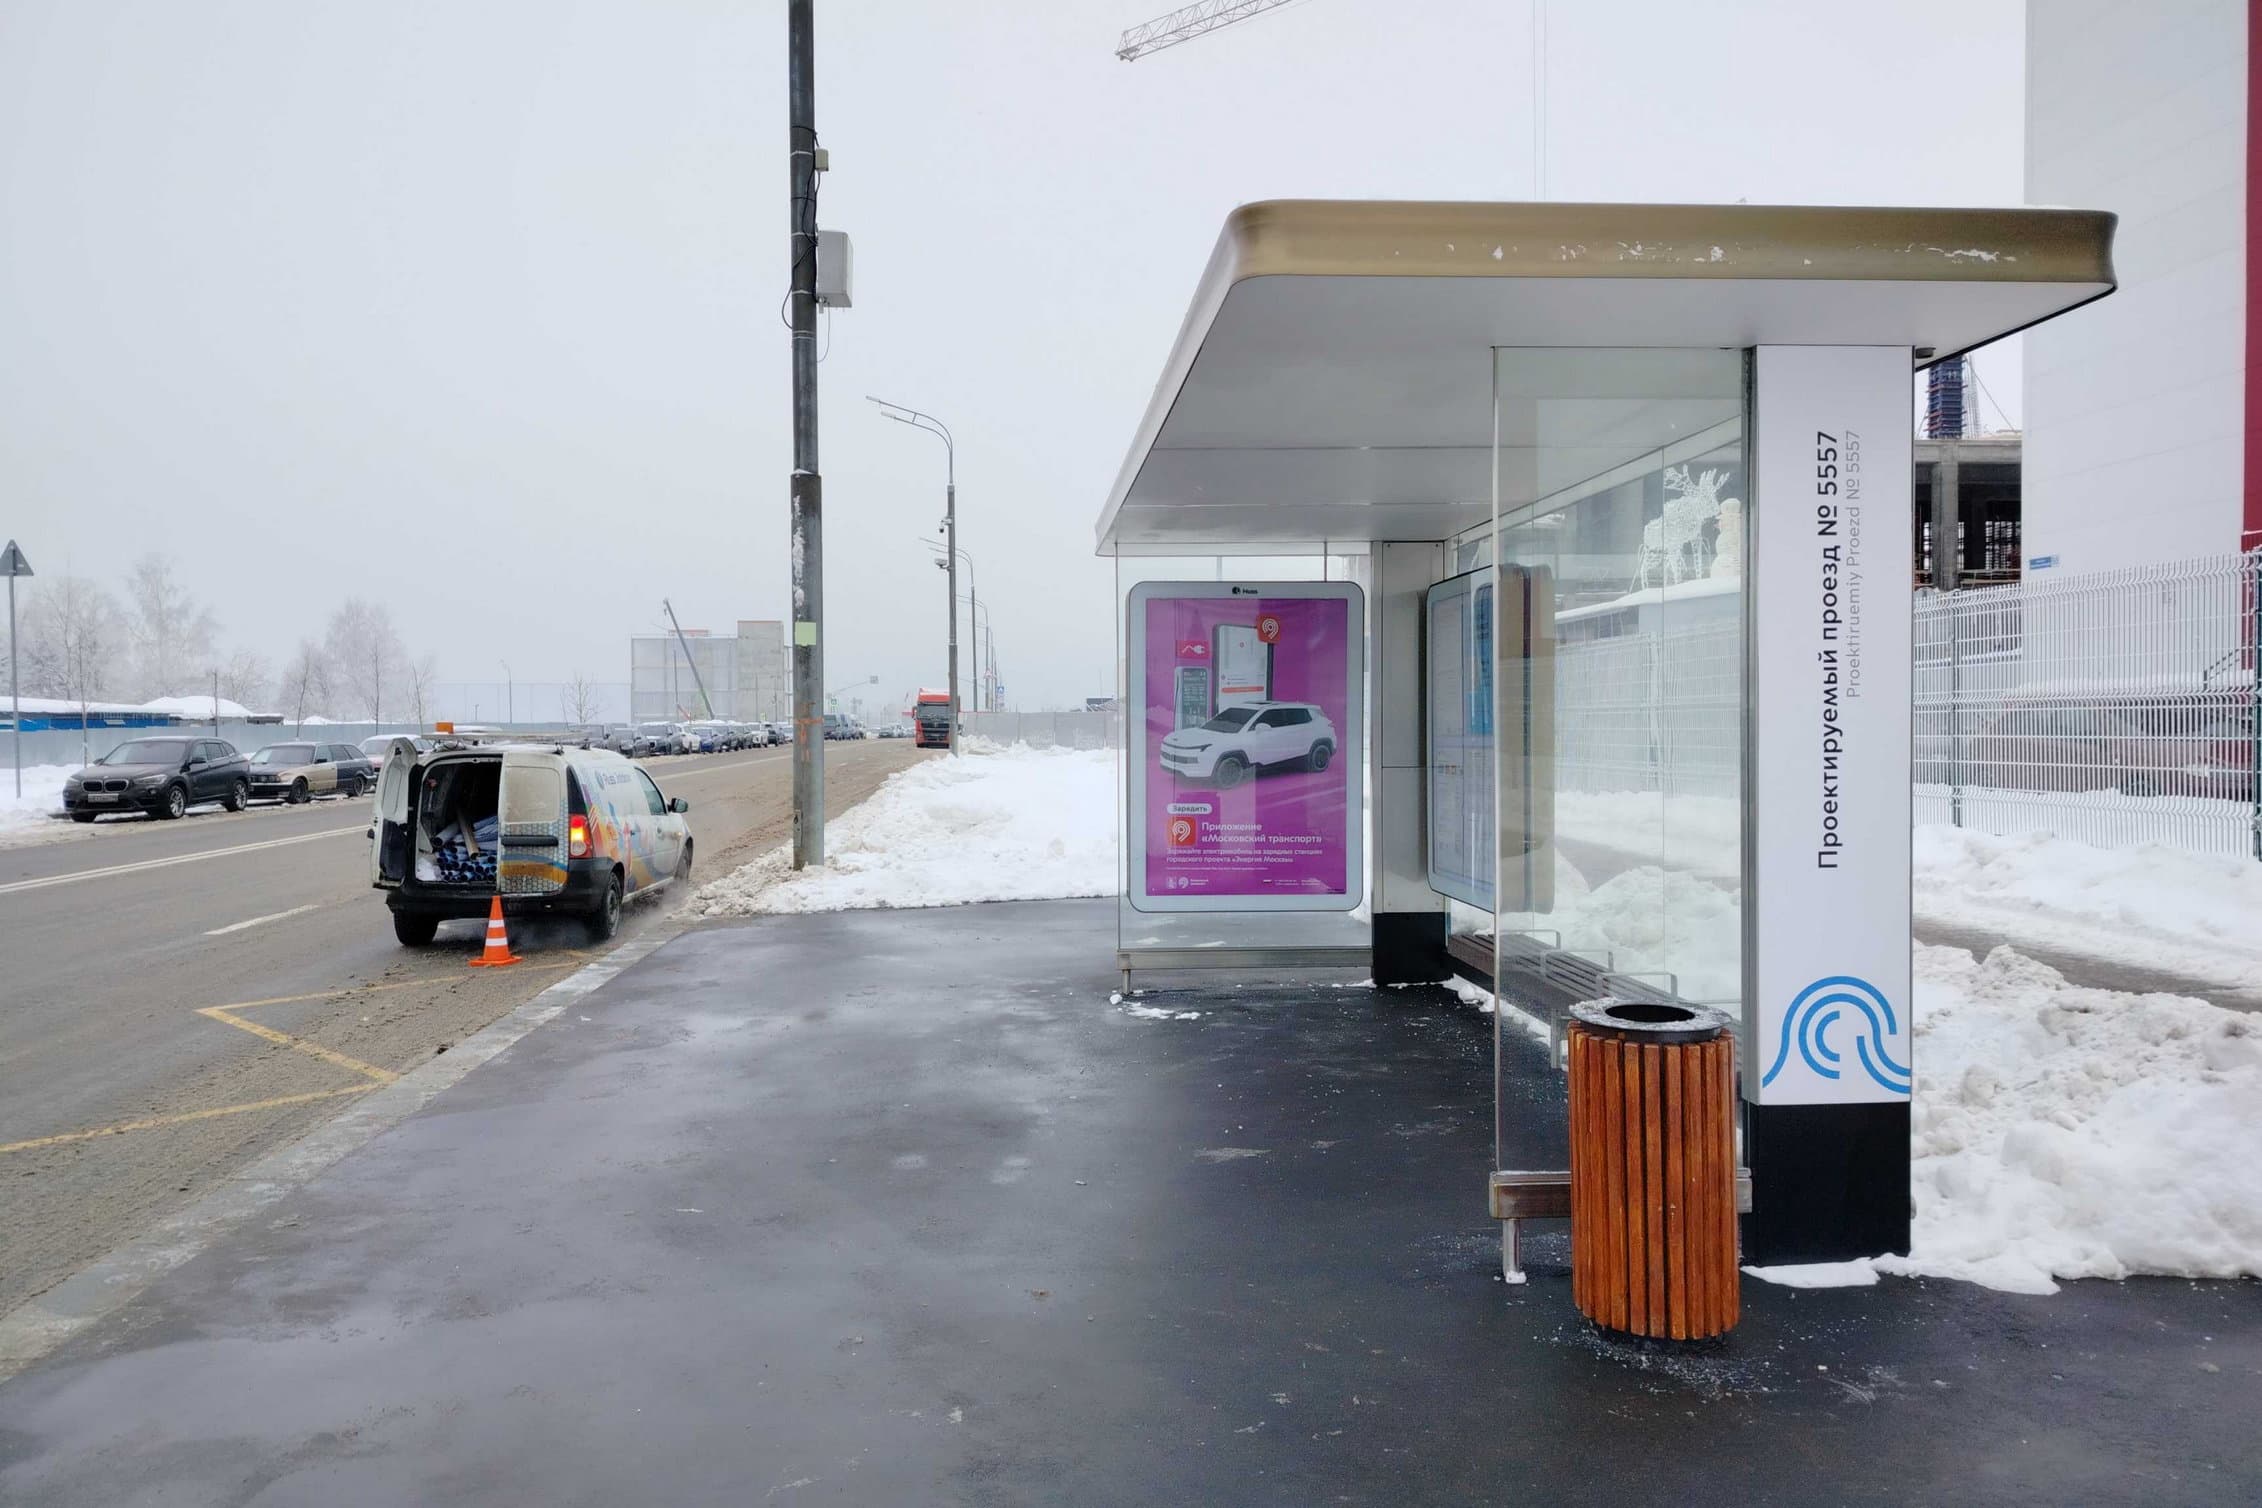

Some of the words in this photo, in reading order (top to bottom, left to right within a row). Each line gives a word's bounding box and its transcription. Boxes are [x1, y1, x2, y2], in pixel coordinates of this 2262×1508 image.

[1817, 431, 1838, 496] 5557
[1845, 430, 1860, 473] 5557
[1846, 479, 1860, 499] №
[1817, 504, 1838, 536] №
[1845, 506, 1860, 566] Proezd
[1822, 545, 1843, 641] проезд
[1845, 571, 1863, 698] Proektiruemiy
[1817, 649, 1843, 869] Проектируемый
[1172, 804, 1208, 813] Зарядить
[1201, 822, 1262, 832] Приложение
[1201, 834, 1266, 844] «Московский
[1268, 835, 1322, 844] транспорт»
